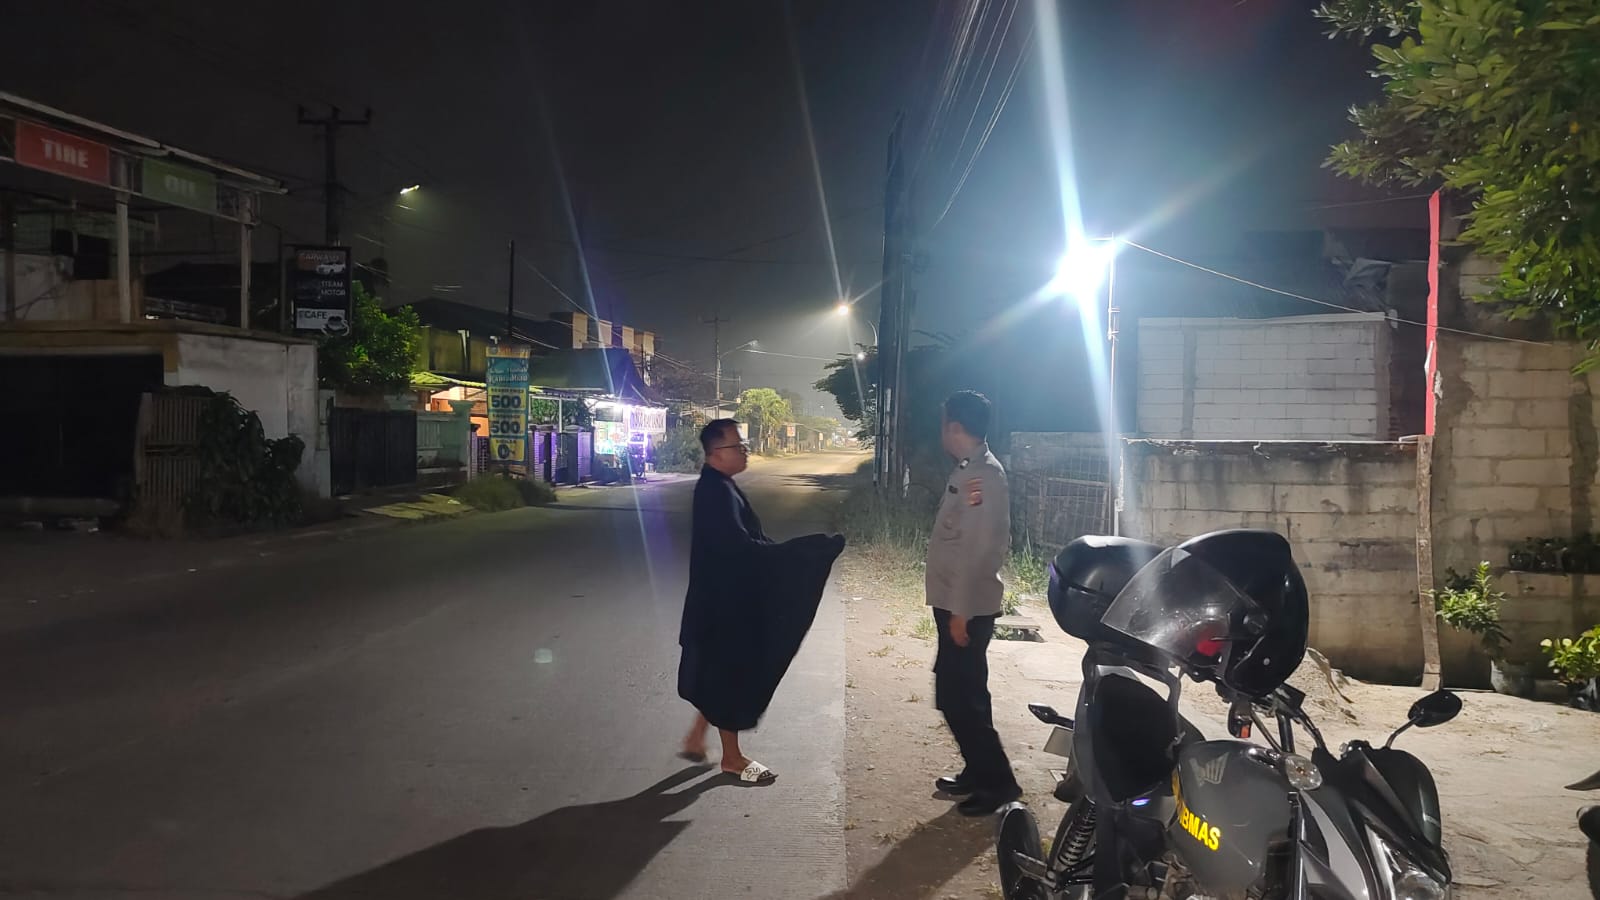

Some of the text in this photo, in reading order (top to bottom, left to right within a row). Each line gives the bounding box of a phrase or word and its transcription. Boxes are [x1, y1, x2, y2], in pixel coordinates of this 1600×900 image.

[42, 138, 89, 169] TIRE
[164, 174, 196, 196] OIL
[321, 280, 344, 288] STEAM
[321, 289, 346, 297] MOTOR
[492, 396, 521, 408] 500
[491, 421, 520, 434] 500
